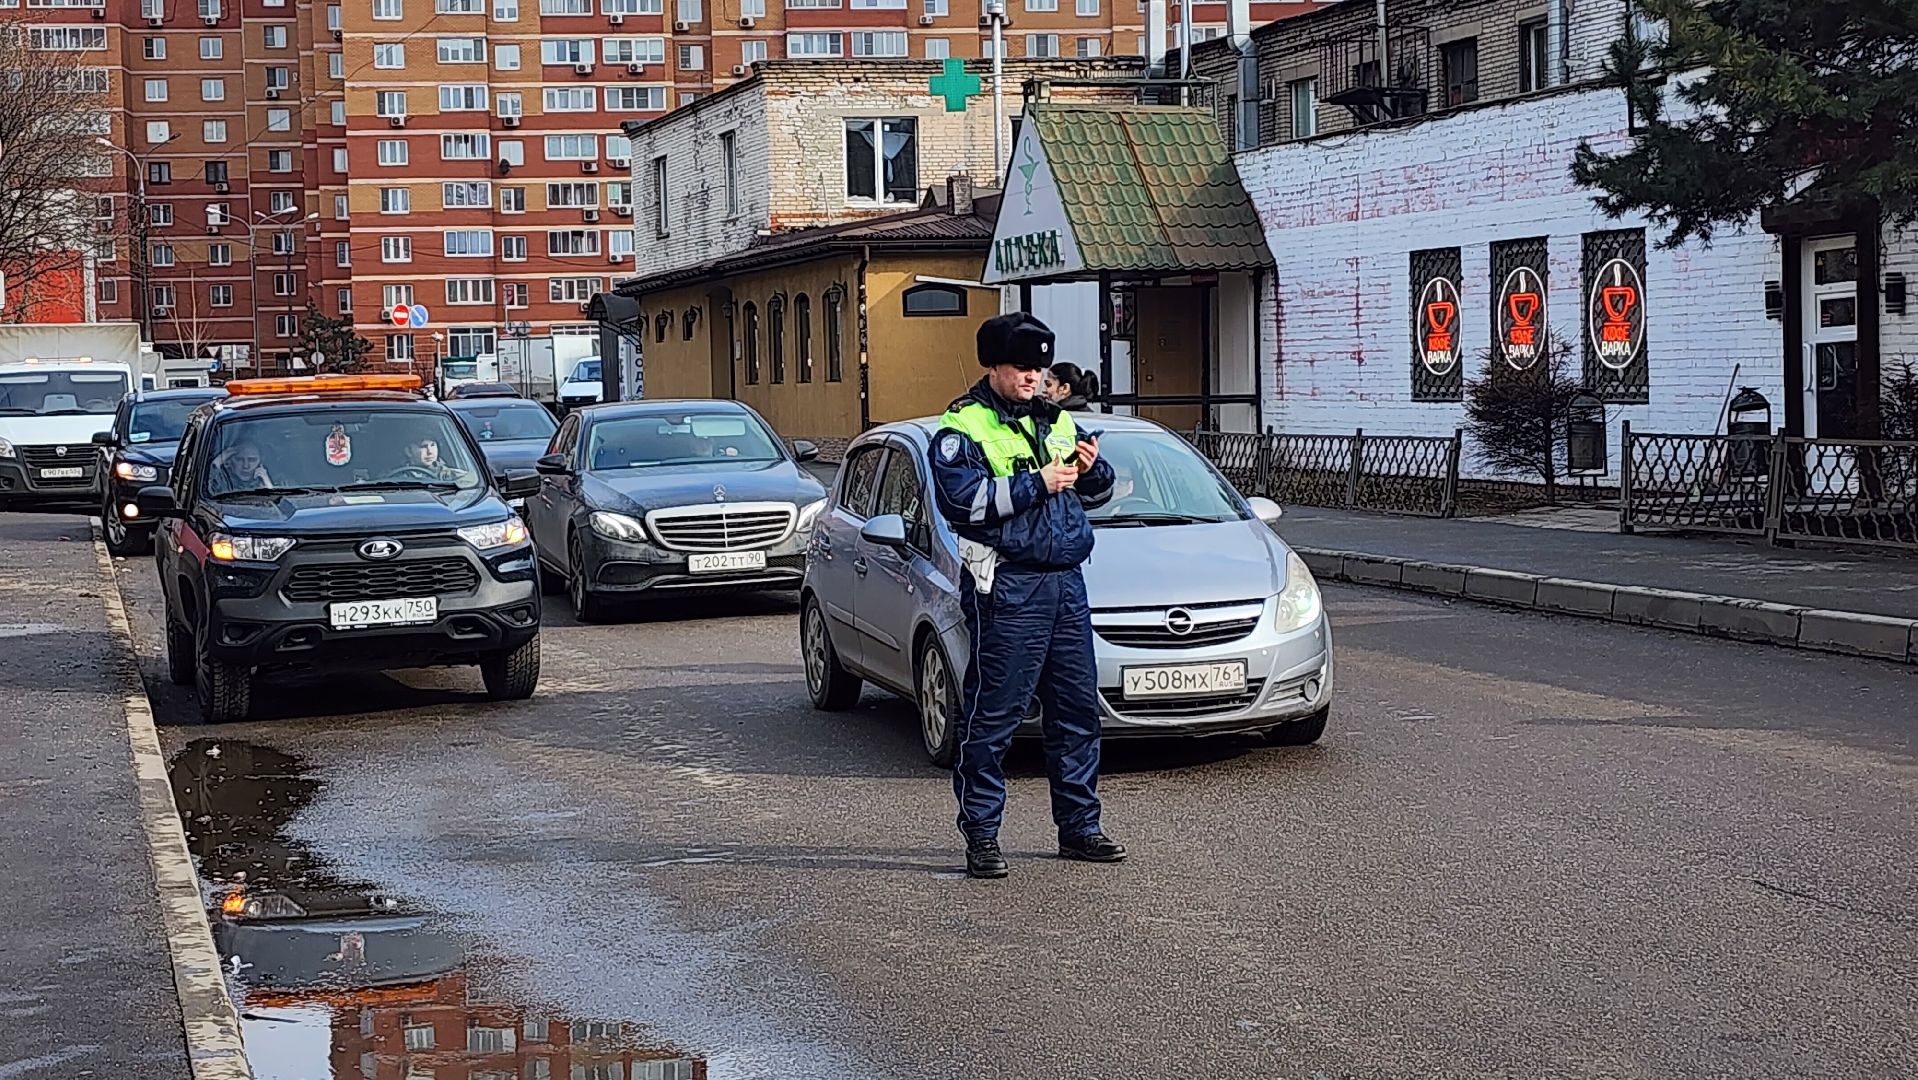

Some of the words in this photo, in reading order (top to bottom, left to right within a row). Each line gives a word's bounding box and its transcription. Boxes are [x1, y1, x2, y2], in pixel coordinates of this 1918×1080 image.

[995, 229, 1063, 272] АПТЕКА
[1603, 326, 1631, 341] КОФЕ
[1428, 335, 1451, 350] КОФЕ
[1602, 341, 1631, 356] ВАРКА
[1427, 350, 1452, 364] ВАРКА
[635, 345, 644, 394] ВОДА
[695, 555, 744, 569] Т202ТТ
[749, 552, 761, 563] 90
[337, 605, 403, 622] Н293КК
[407, 600, 433, 614] 750
[1131, 670, 1209, 692] У508МХ
[1212, 665, 1241, 682] 761
